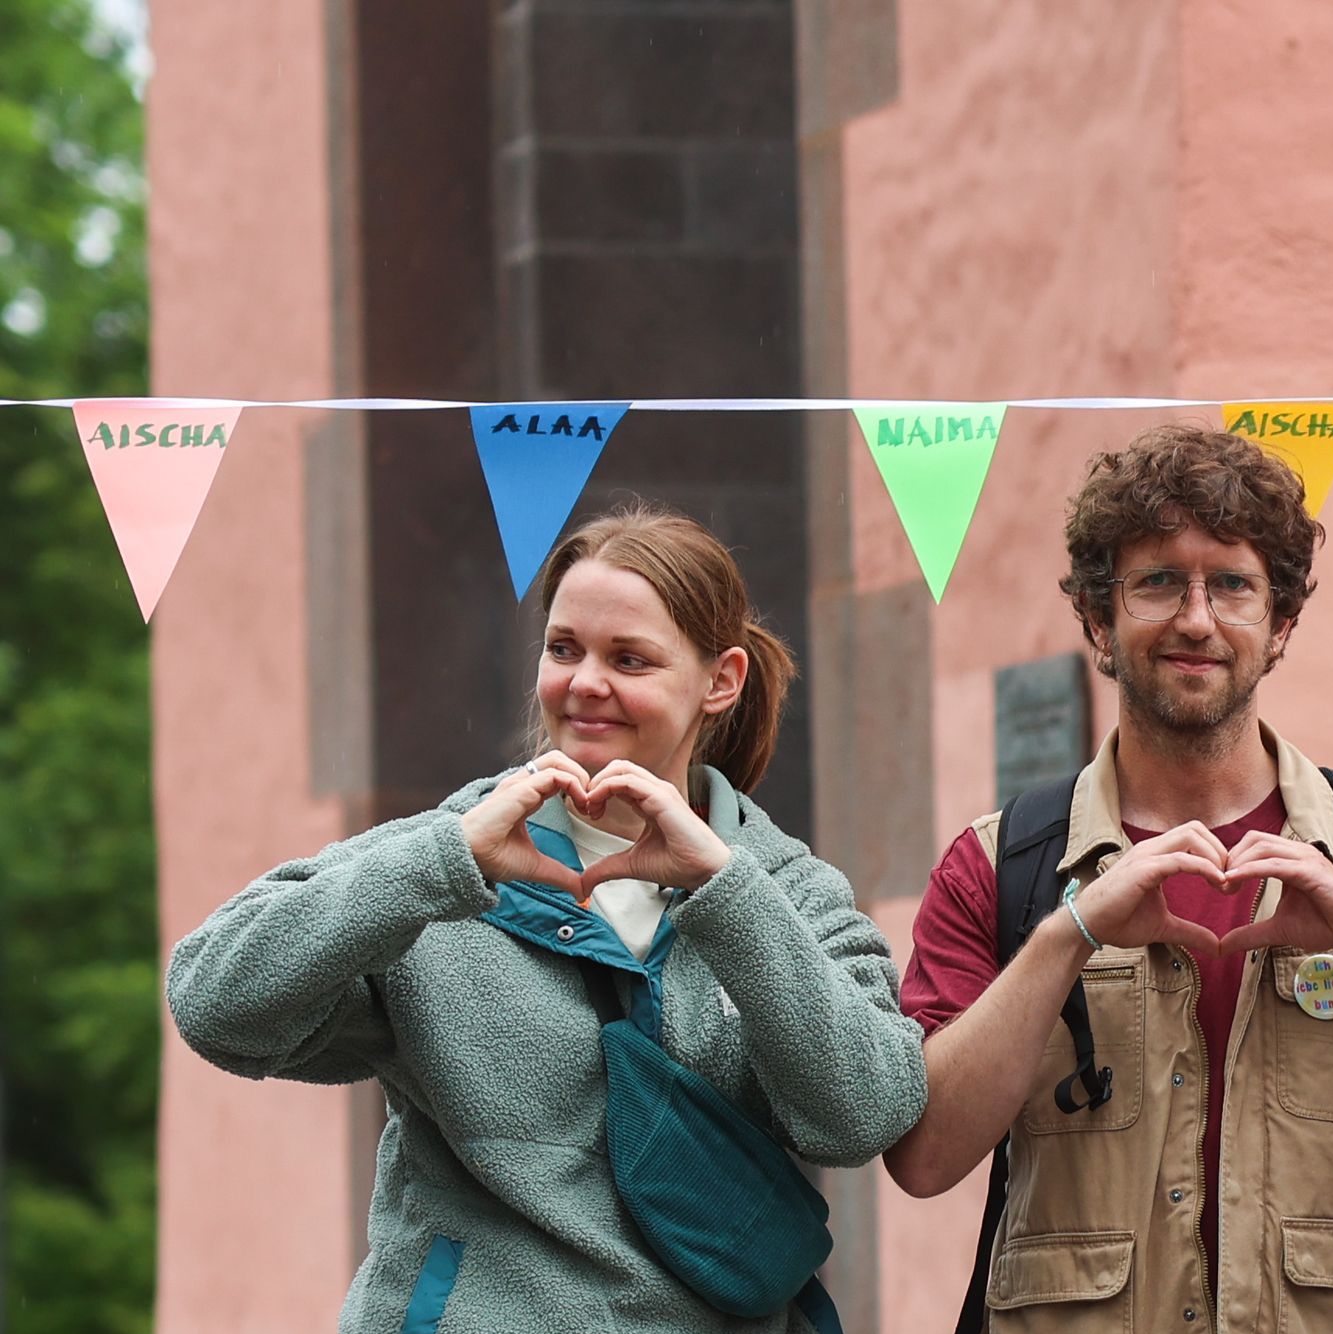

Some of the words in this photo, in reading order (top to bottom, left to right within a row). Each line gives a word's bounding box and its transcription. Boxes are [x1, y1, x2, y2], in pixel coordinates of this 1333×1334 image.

[87, 421, 227, 449] AISCHA
[491, 414, 606, 440] ALAA
[877, 416, 998, 447] NAIMA
